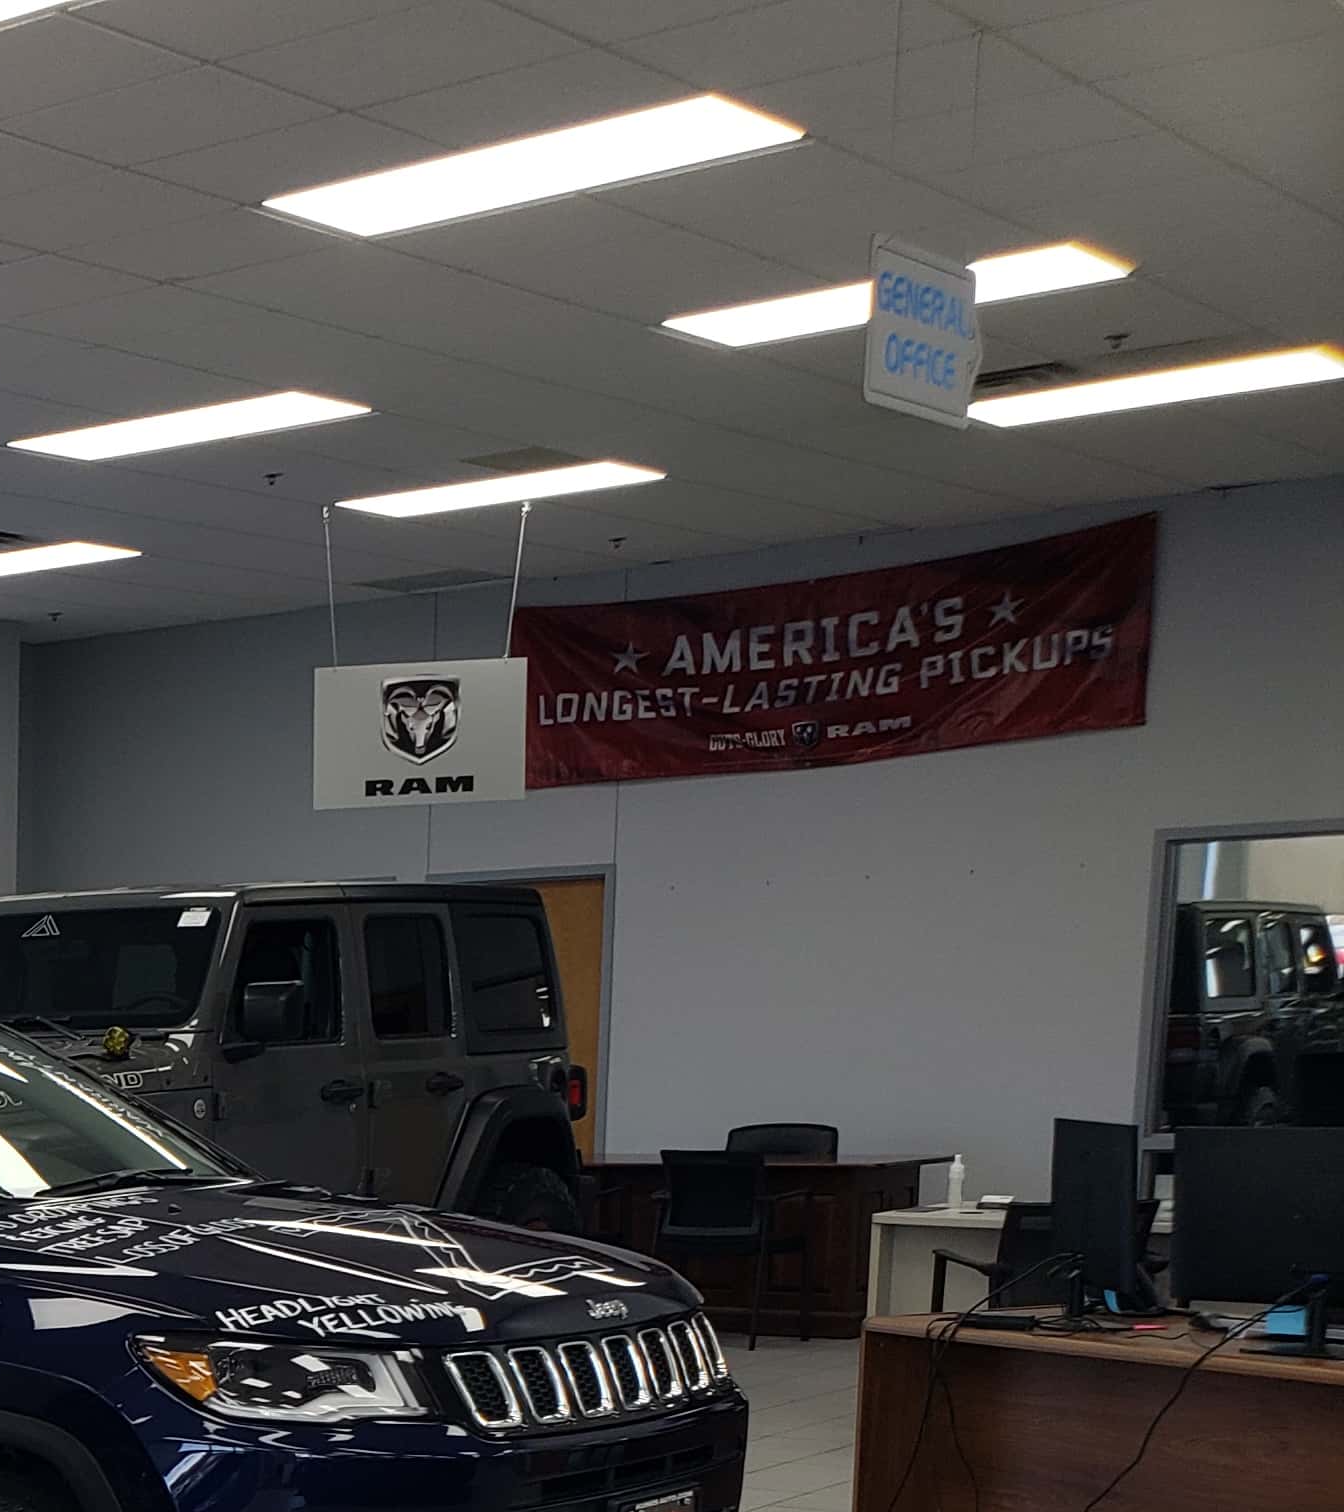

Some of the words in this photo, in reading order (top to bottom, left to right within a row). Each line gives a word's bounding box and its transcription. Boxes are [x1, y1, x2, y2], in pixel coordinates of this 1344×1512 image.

[877, 270, 975, 341] GENERAL
[885, 332, 957, 391] OFFICE
[662, 597, 964, 676] AMERICA'S
[539, 663, 903, 726] LONGEST-LASTING
[919, 624, 1114, 689] PICKUPS
[826, 715, 912, 738] RAM
[365, 775, 474, 797] RAM
[36, 1233, 106, 1255] TREE
[94, 1240, 181, 1264] LOSS
[158, 1228, 201, 1246] OF
[215, 1294, 387, 1331] HEADLIGHT
